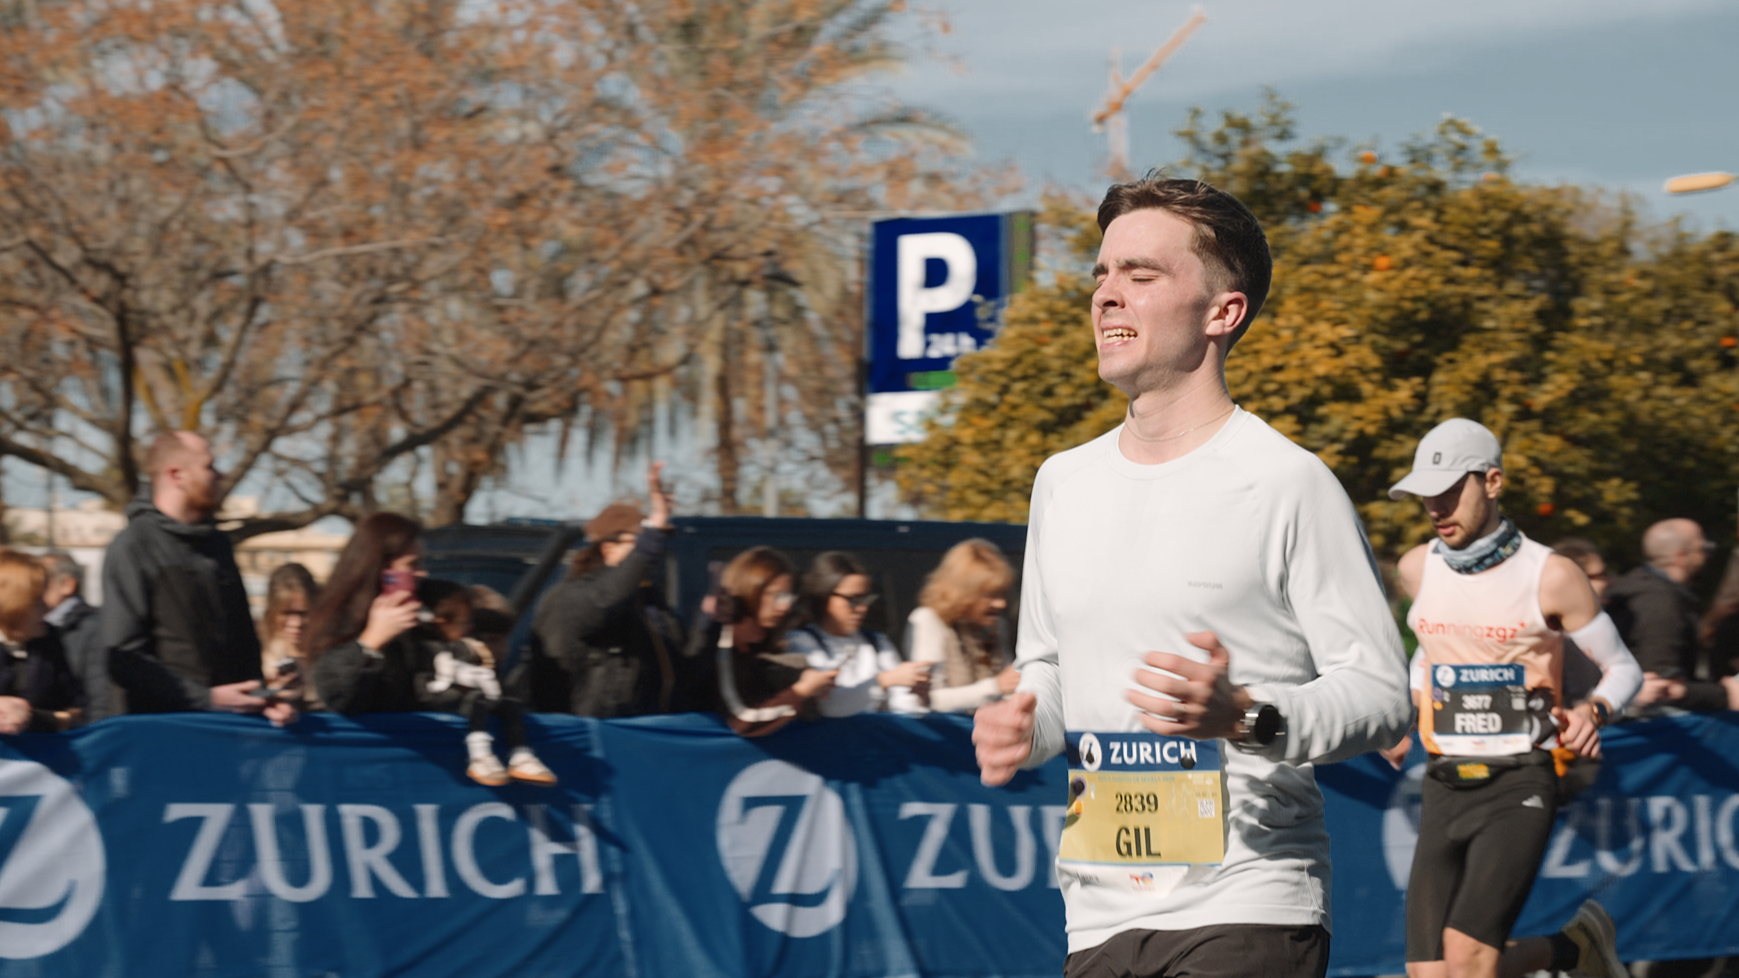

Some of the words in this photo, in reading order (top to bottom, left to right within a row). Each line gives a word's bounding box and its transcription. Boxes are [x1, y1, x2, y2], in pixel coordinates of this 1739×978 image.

[896, 232, 977, 359] P
[1459, 668, 1516, 682] ZURICH
[1454, 712, 1503, 733] FRED
[1109, 741, 1197, 765] ZURICH
[1115, 793, 1159, 814] 2839
[162, 802, 605, 903] ZURICH
[1115, 827, 1161, 858] GIL
